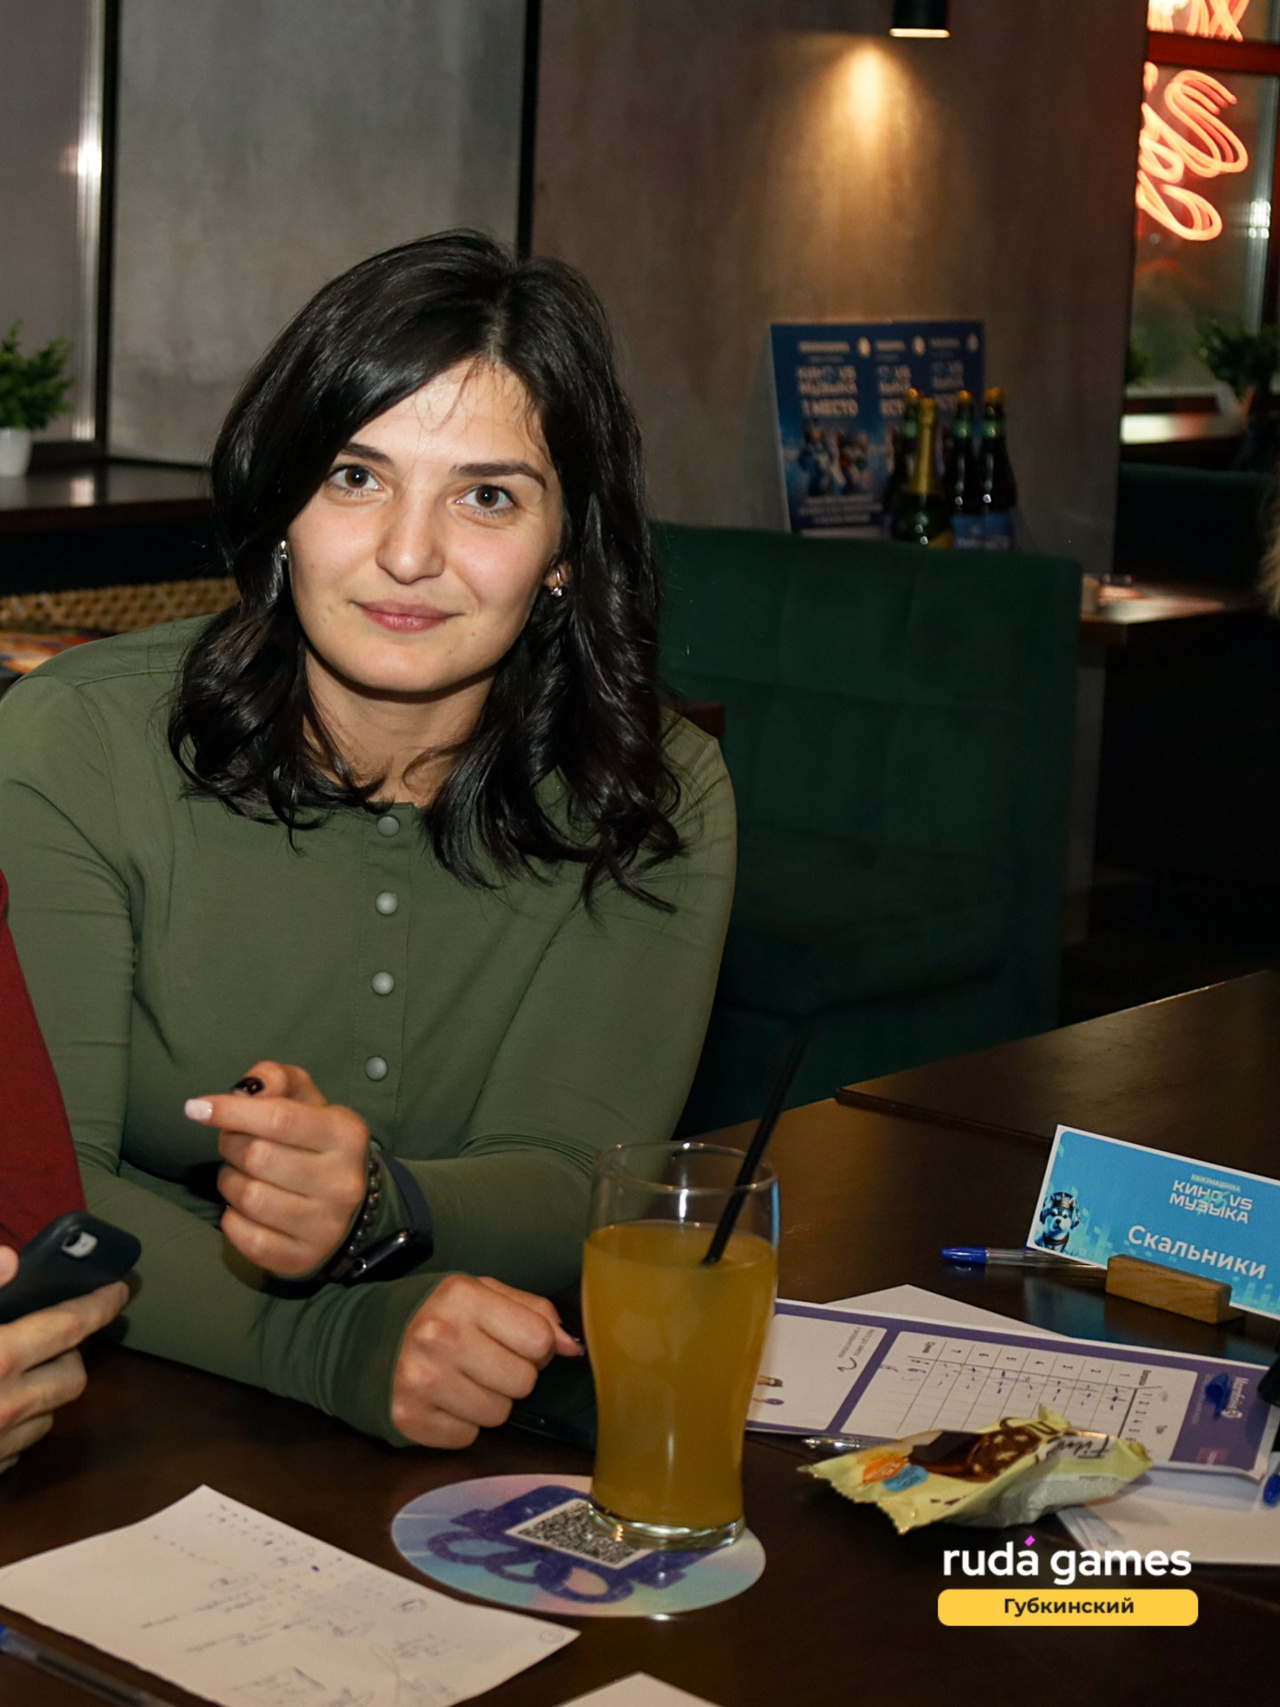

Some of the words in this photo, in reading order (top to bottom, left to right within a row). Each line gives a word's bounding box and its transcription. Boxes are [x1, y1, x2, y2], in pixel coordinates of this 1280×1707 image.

[1169, 1193, 1249, 1224] МУЗЫКА
[1172, 1180, 1222, 1201] КИНО
[1229, 1194, 1253, 1211] VS
[1128, 1225, 1267, 1279] Скальники
